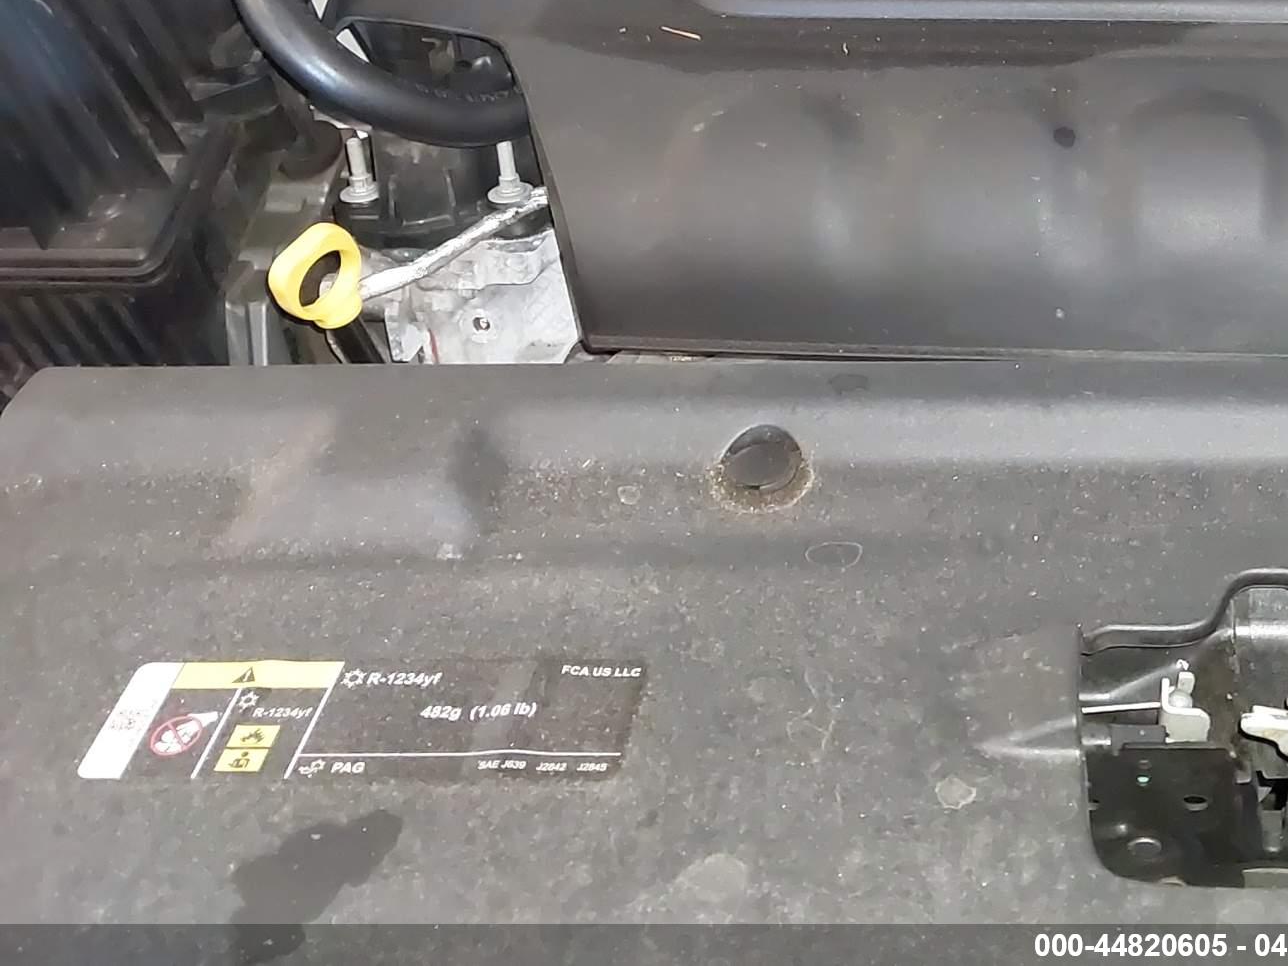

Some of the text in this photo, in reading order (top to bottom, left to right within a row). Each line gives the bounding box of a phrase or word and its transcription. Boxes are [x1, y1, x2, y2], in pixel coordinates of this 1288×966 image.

[561, 665, 642, 677] FCA US LLC
[367, 672, 442, 688] R-1234yf
[252, 707, 314, 723] R-1234yf
[420, 702, 537, 721] 482g (1.06 lb)
[330, 761, 366, 773] PAG
